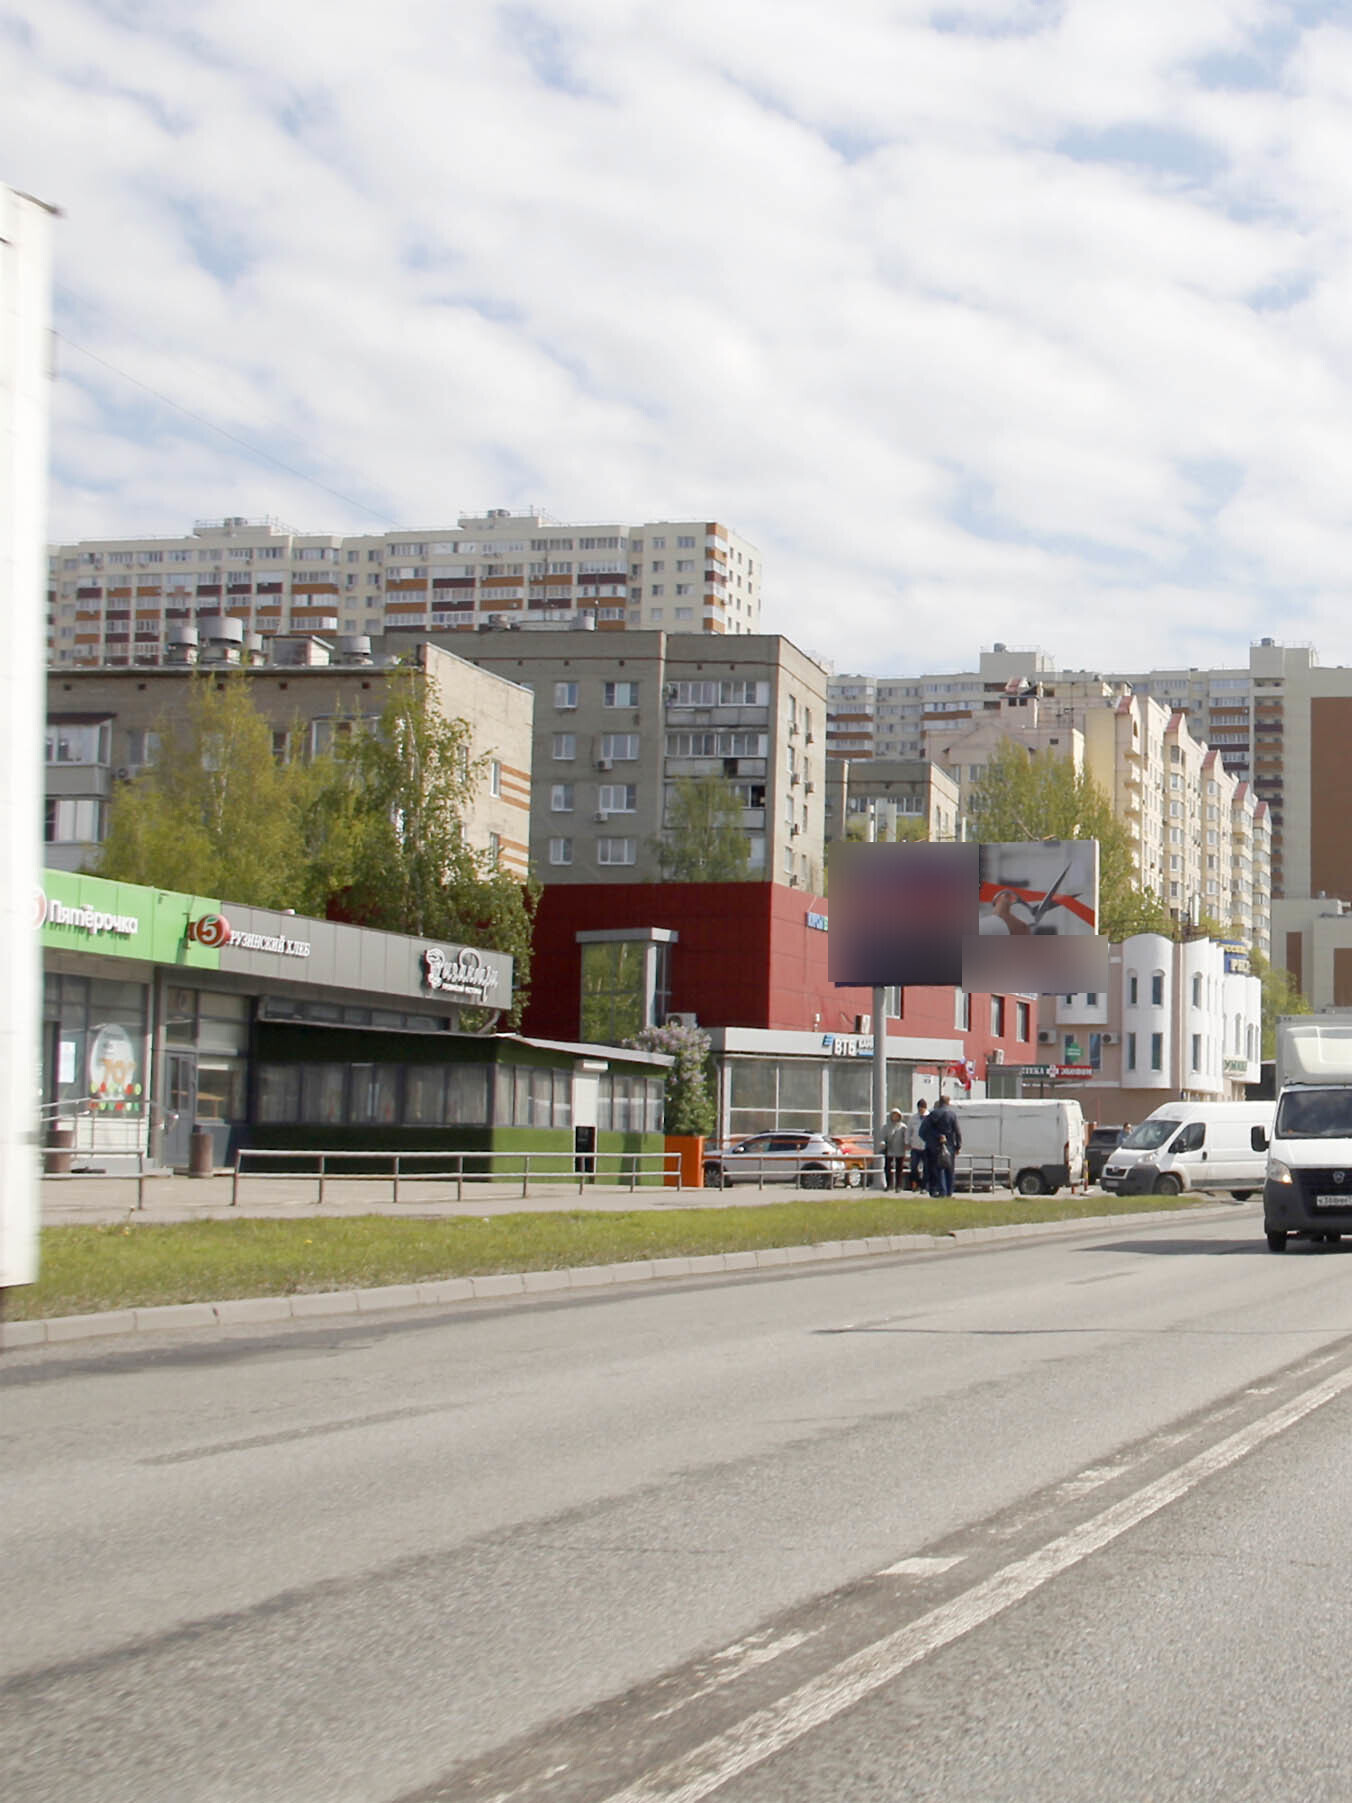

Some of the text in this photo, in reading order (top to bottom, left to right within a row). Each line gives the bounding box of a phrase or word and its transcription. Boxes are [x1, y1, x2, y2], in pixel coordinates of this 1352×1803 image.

[48, 899, 139, 935] Пятёрочка
[201, 919, 217, 941] 5
[227, 929, 284, 953] РУЗИНСКИЙ
[834, 1038, 857, 1056] ВТБ
